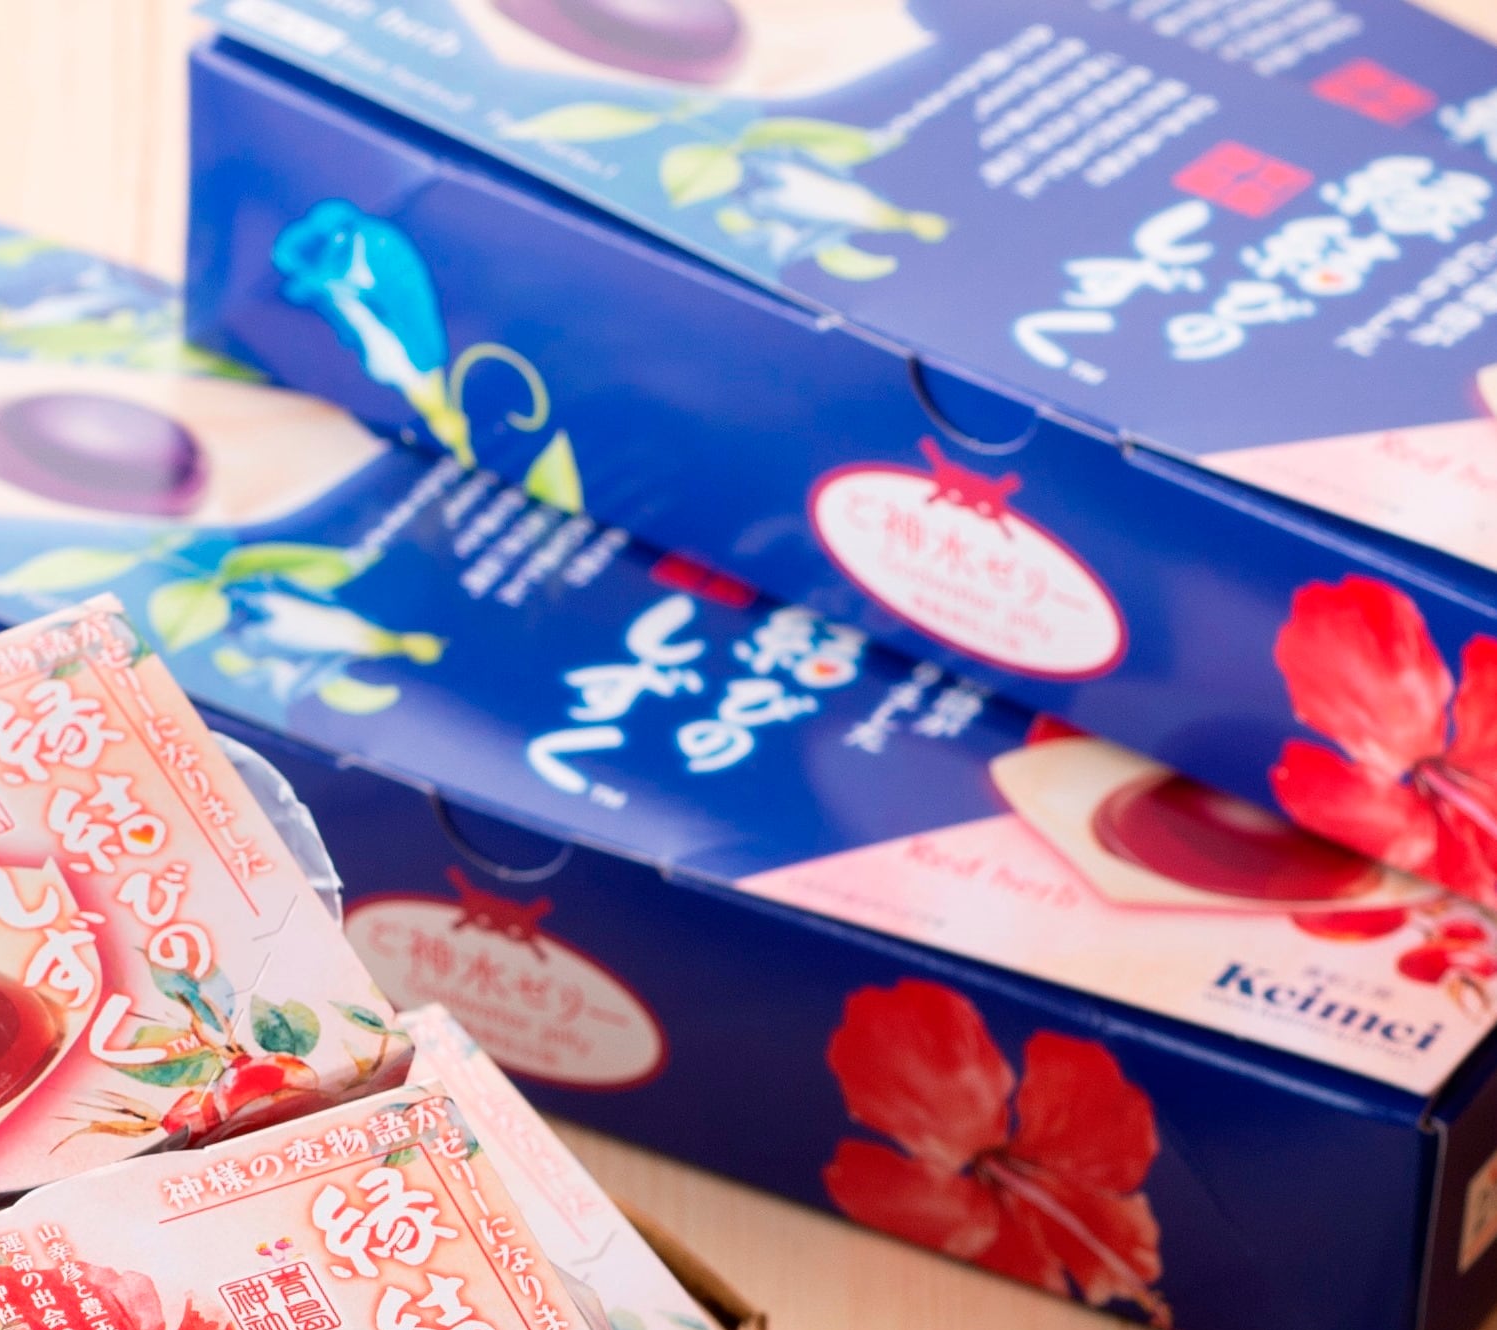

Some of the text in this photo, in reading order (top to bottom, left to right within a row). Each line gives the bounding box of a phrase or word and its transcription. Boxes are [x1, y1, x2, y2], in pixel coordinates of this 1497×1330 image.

[1211, 960, 1445, 1053] Keimei
[162, 1101, 448, 1209] 神様の恋物語が
